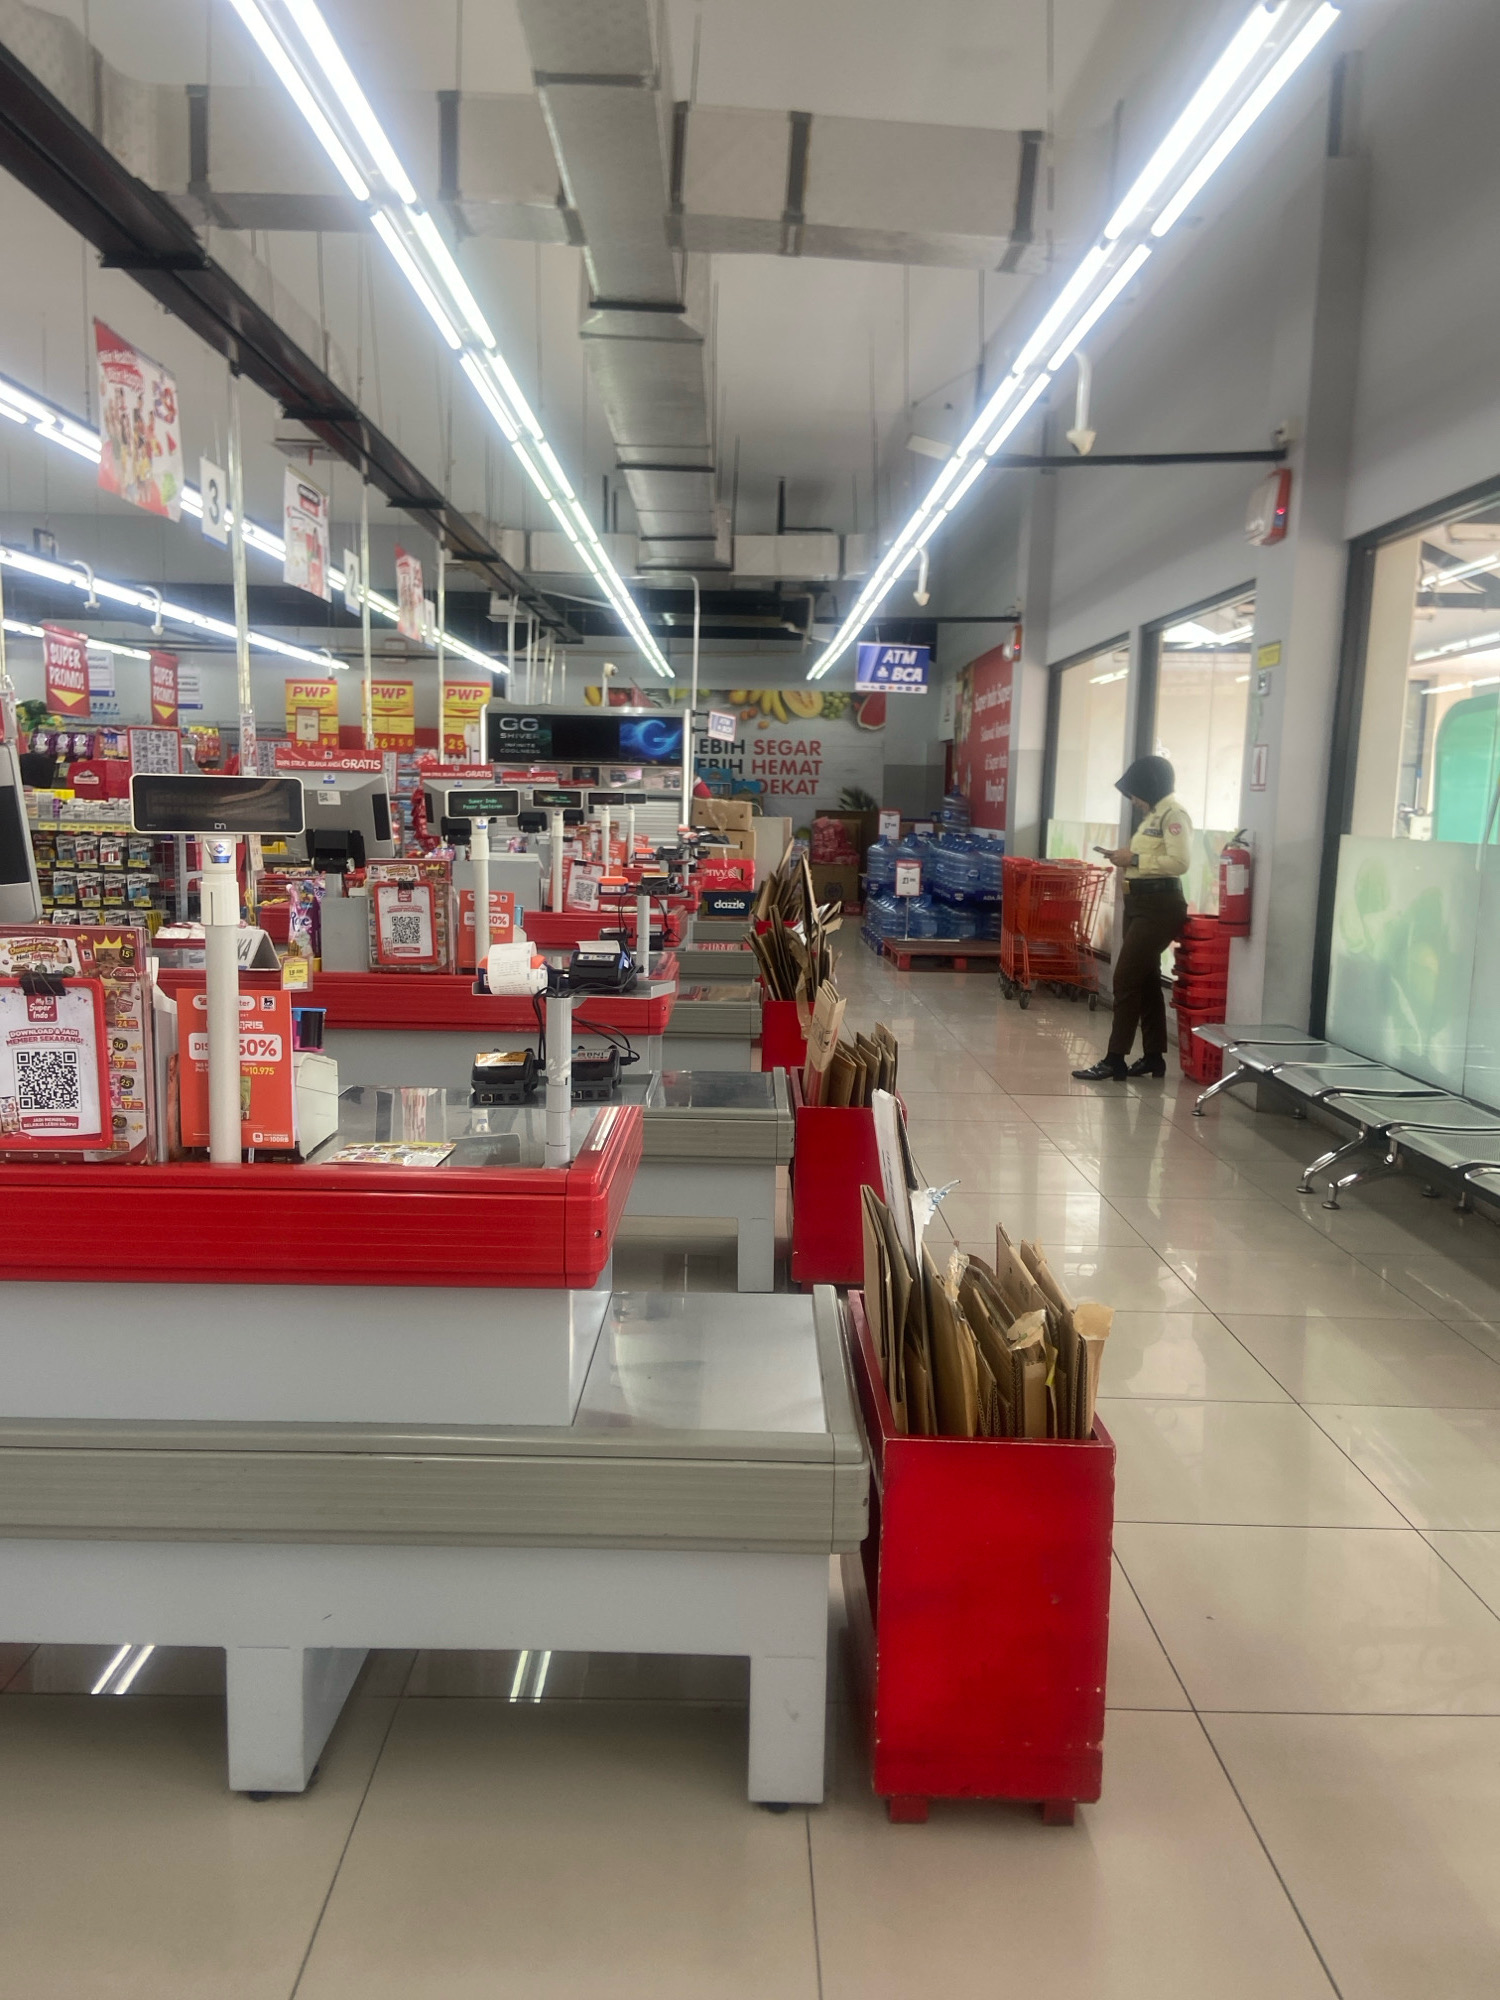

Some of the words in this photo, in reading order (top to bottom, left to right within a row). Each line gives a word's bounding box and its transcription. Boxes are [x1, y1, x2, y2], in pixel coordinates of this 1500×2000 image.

[209, 479, 220, 525] 3
[50, 643, 82, 669] SUPER
[882, 649, 917, 664] ATM
[50, 666, 85, 690] PROMO!
[153, 666, 174, 686] SUPER
[891, 667, 923, 682] BCA
[293, 686, 331, 698] PWP
[371, 687, 407, 699] PWP
[446, 688, 484, 700] PWP
[500, 718, 539, 731] GG
[694, 739, 745, 755] EBIH
[754, 739, 822, 756] SEGAR
[341, 758, 381, 769] GRATIS
[752, 759, 823, 776] HEMAT
[465, 770, 493, 778] GRATIS
[714, 900, 745, 909] dazzle
[29, 1003, 52, 1012] Super
[9, 1028, 54, 1039] DOWNLOAD
[60, 1028, 79, 1037] JADI
[6, 1036, 39, 1046] MEMBER
